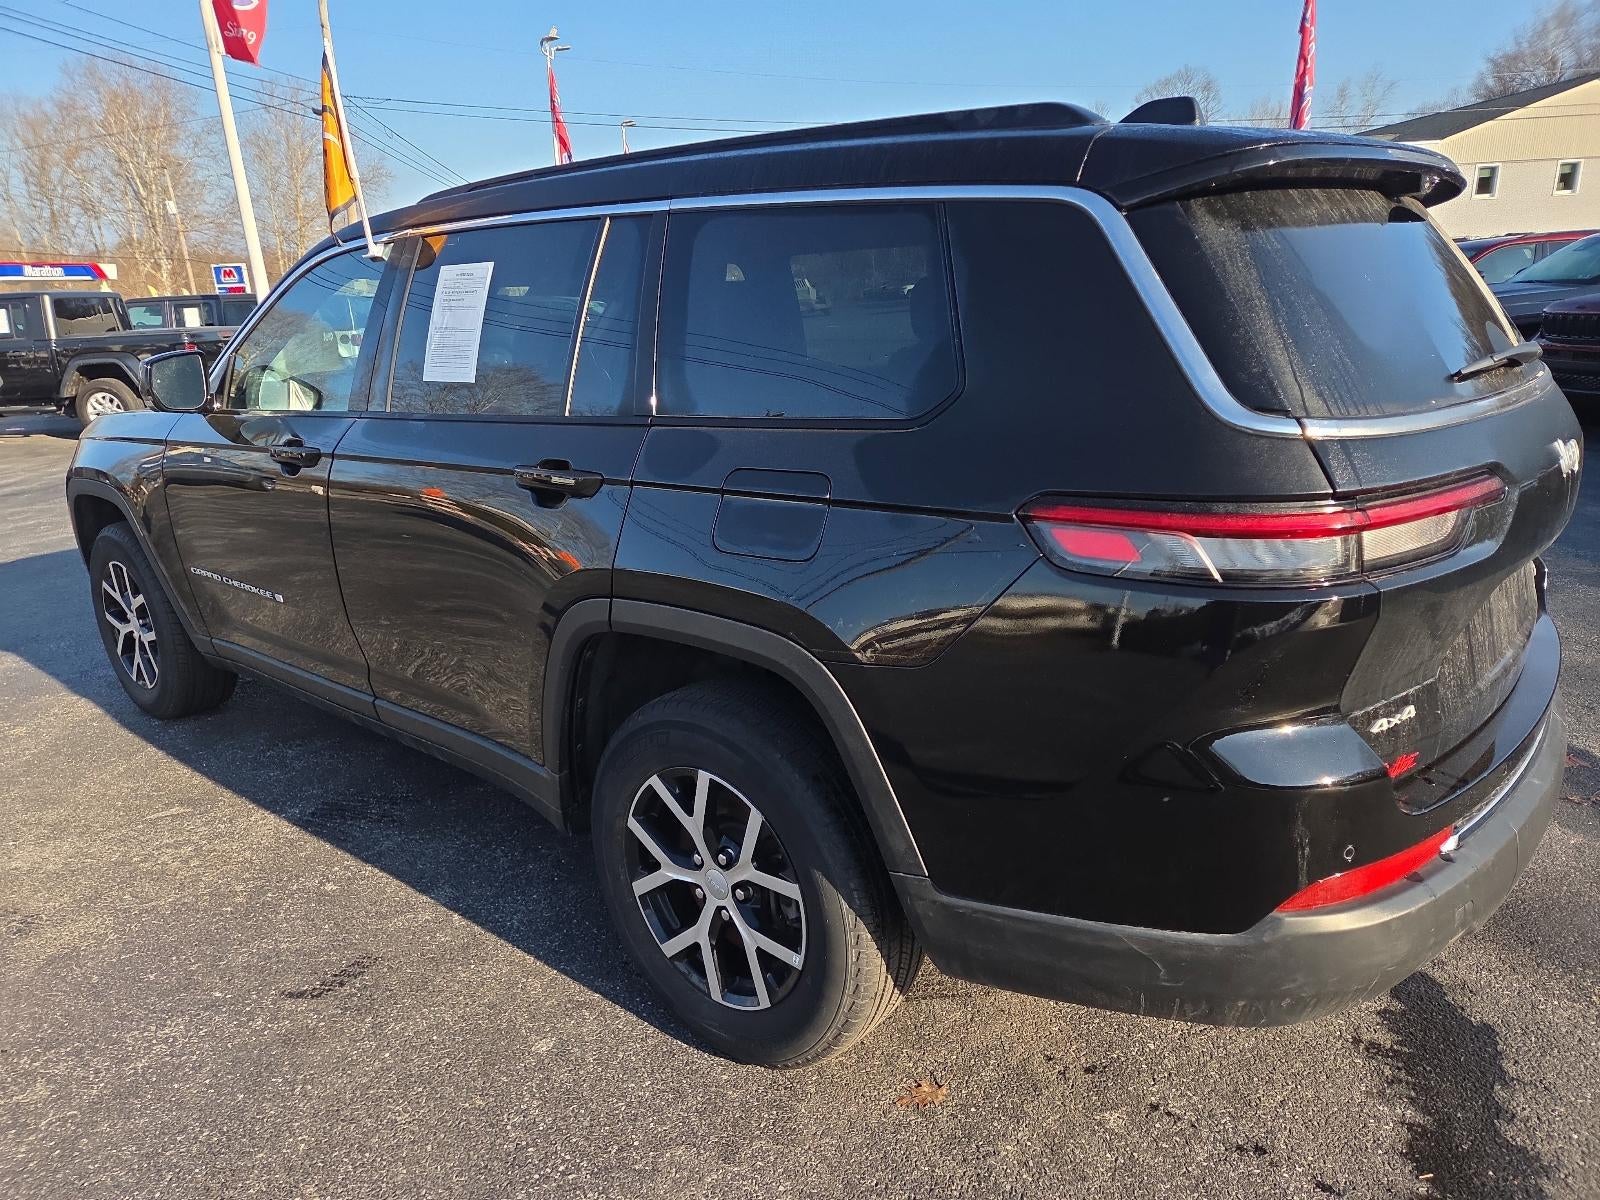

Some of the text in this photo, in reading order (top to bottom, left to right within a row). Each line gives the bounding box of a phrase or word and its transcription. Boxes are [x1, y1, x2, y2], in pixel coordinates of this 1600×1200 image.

[24, 265, 64, 277] Marathon
[223, 269, 236, 278] M
[190, 567, 274, 600] GRAND CHEROKEE
